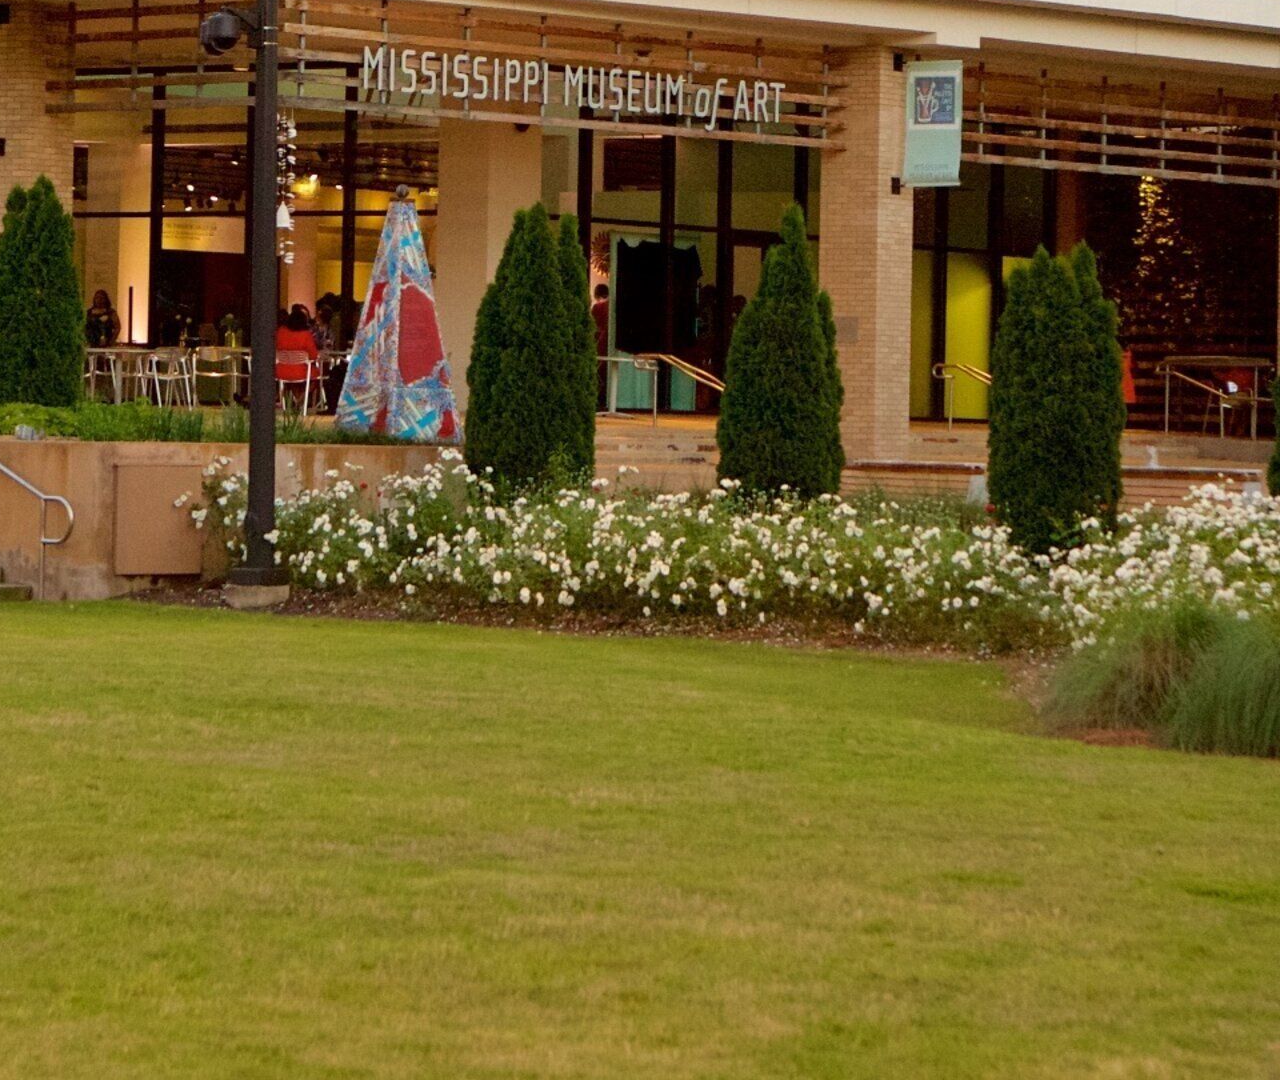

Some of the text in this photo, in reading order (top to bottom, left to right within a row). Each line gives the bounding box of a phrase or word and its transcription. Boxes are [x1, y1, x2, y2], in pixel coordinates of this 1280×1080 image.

[362, 45, 786, 131] MISSISSIPPI MUSEUM of ART
